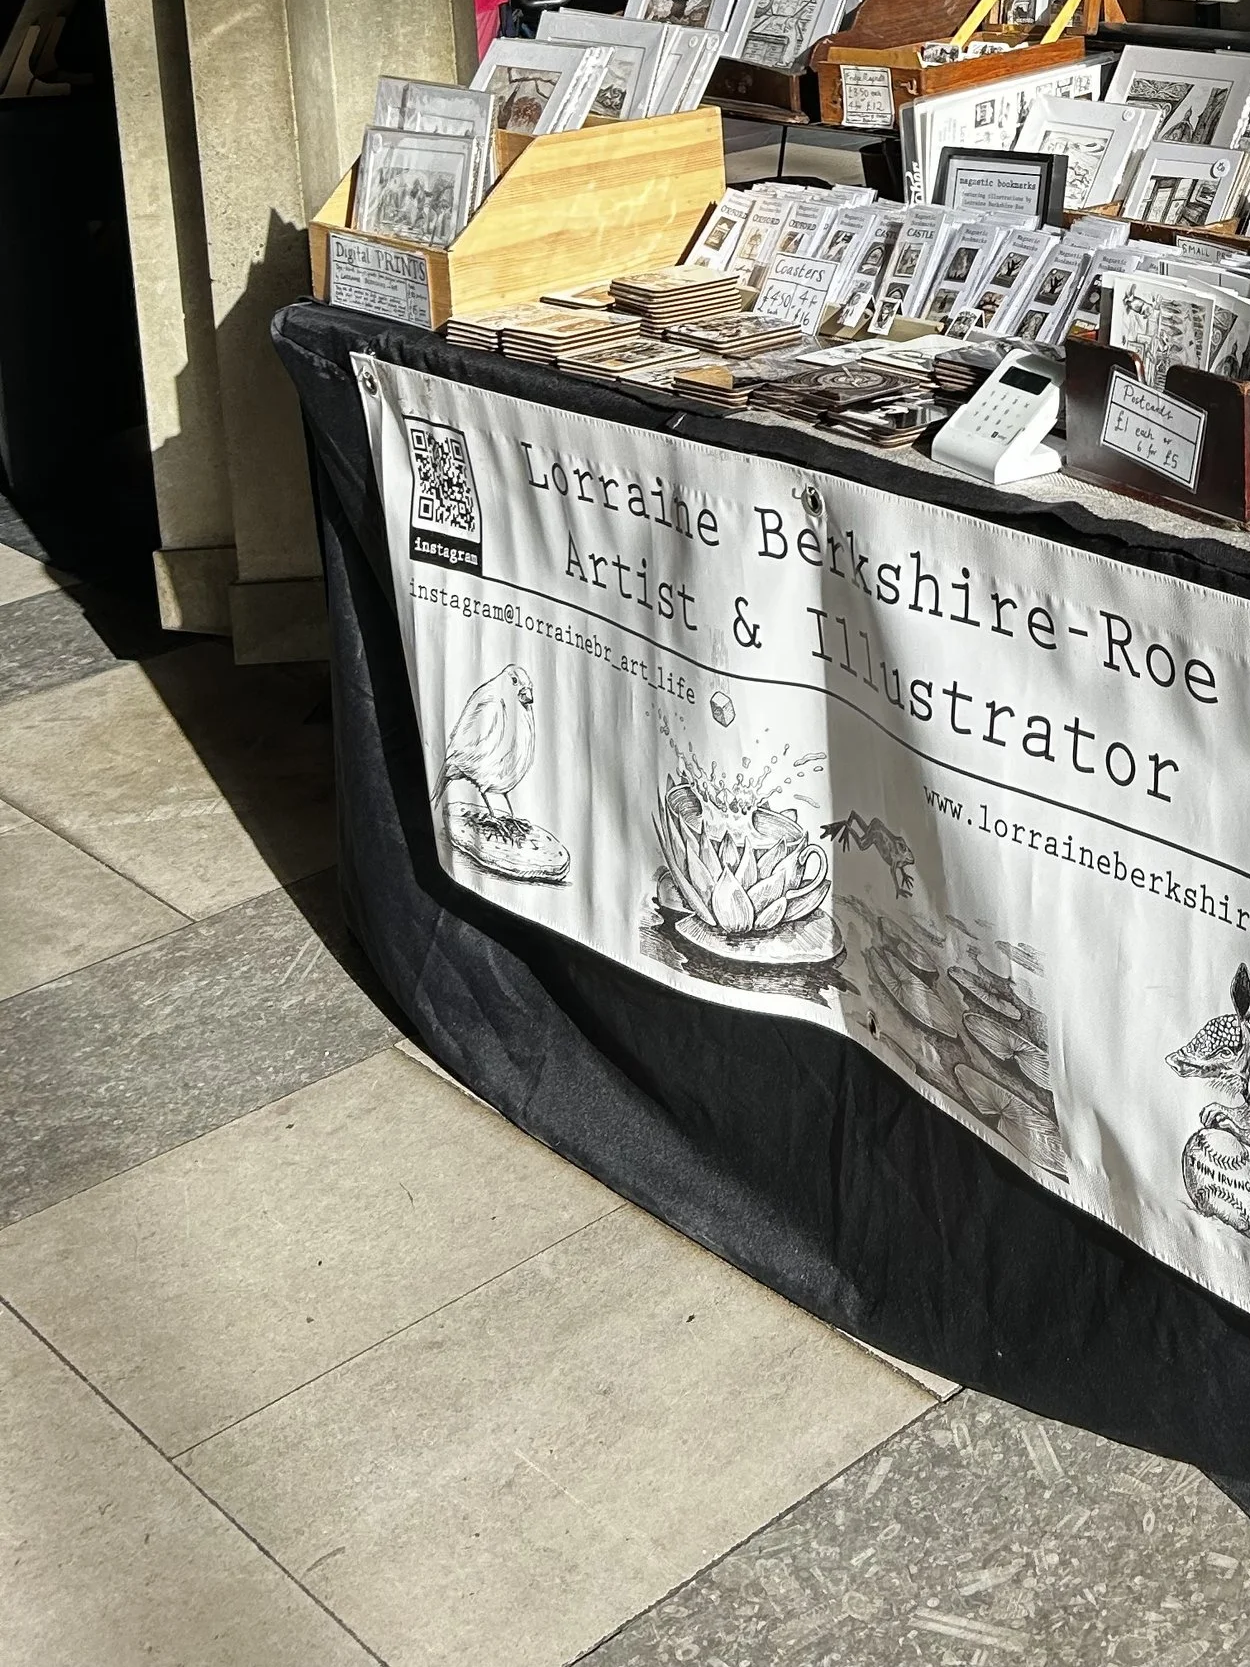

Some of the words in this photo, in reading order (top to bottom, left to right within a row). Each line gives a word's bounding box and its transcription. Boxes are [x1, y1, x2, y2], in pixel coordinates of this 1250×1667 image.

[866, 102, 885, 112] £12
[960, 177, 994, 188] magnetic
[997, 178, 1037, 191] bookmarks
[907, 228, 935, 240] CASTLE
[336, 242, 371, 265] Digital
[375, 250, 426, 282] PRINTS
[1182, 243, 1210, 257] SMALL
[775, 259, 826, 282] Coasters
[1123, 384, 1174, 421] Postcards
[1114, 410, 1129, 433] £1
[1135, 427, 1156, 440] each
[1163, 437, 1174, 446] or
[1136, 440, 1142, 452] 6
[1147, 444, 1158, 459] for
[1162, 449, 1179, 469] £5
[414, 536, 478, 566] instagram
[520, 441, 720, 548] Lorraine
[754, 504, 1220, 707] Berkshire-Roe
[408, 577, 696, 706] instagram@lorrainebr_art_life
[565, 530, 698, 631] Artist
[731, 595, 762, 651] &
[806, 606, 1180, 805] Illustrator
[1186, 1155, 1215, 1181] JOHN
